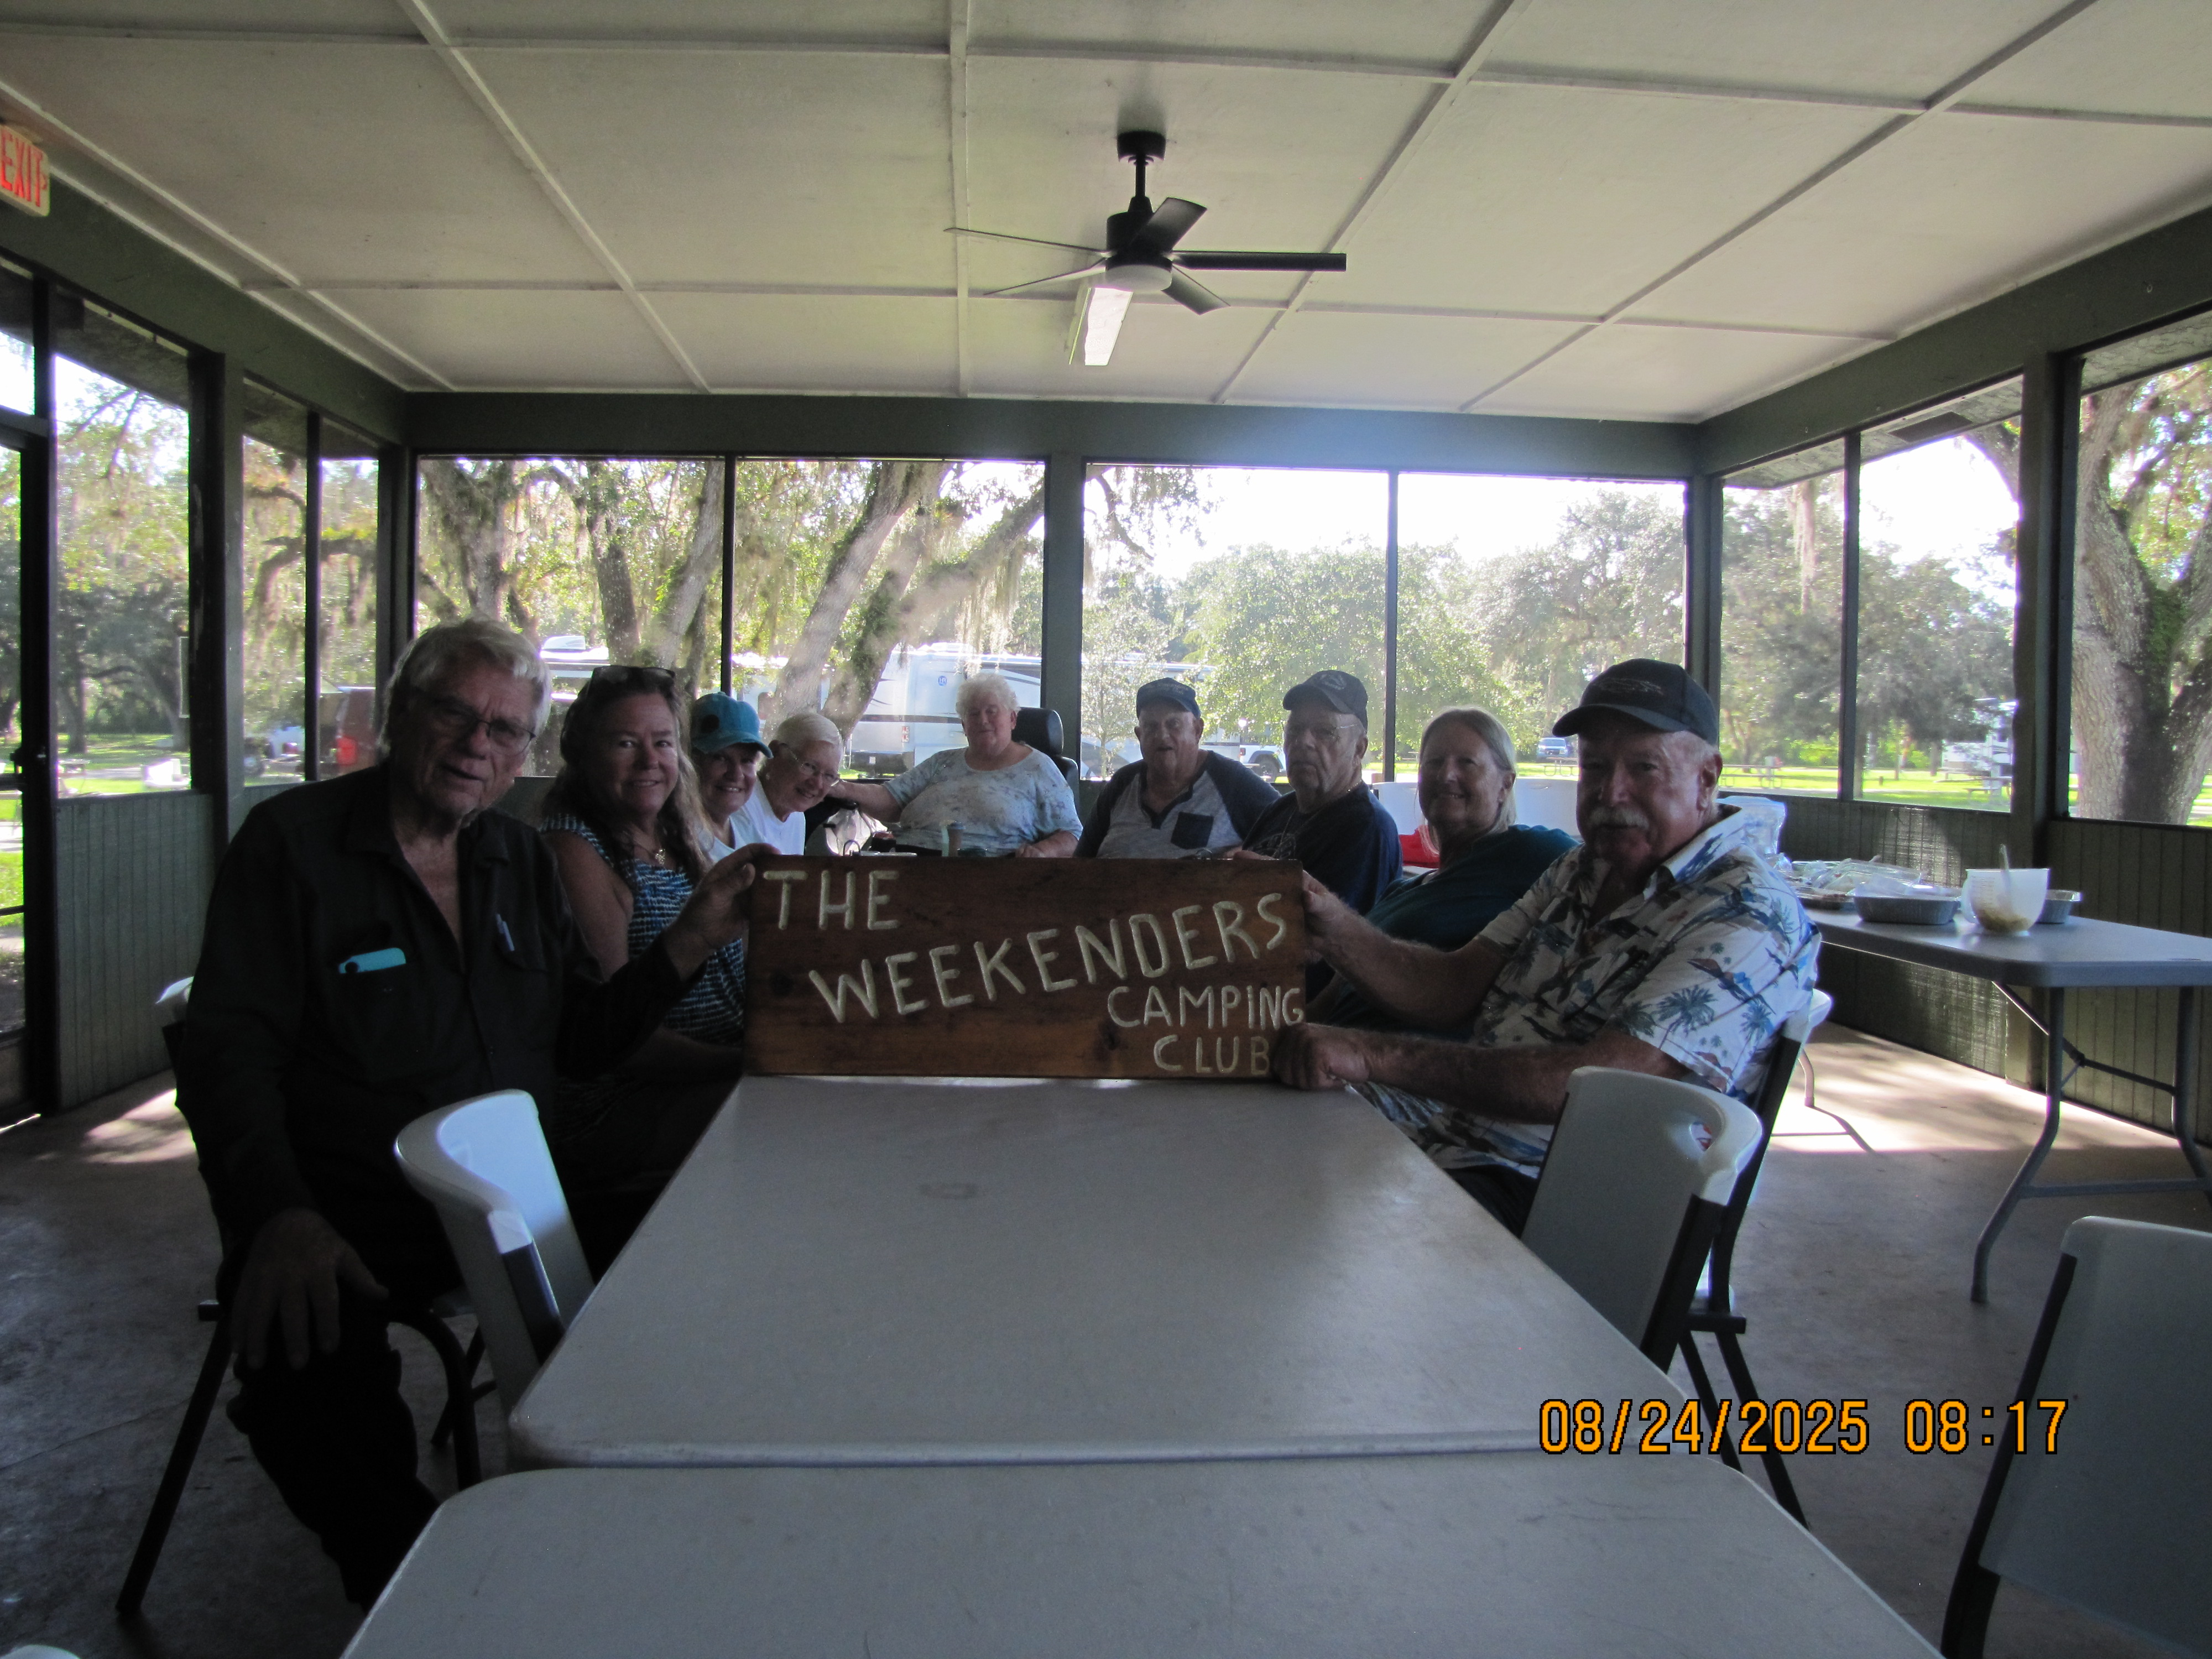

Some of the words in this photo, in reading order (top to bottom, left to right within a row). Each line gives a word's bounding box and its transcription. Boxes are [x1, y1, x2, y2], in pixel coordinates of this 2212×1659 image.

[0, 128, 43, 207] EXIT
[763, 870, 899, 930] THE
[808, 893, 1286, 1022] WEEKENDERS
[1107, 985, 1304, 1030] CAMPING
[1154, 1035, 1270, 1075] CLUB
